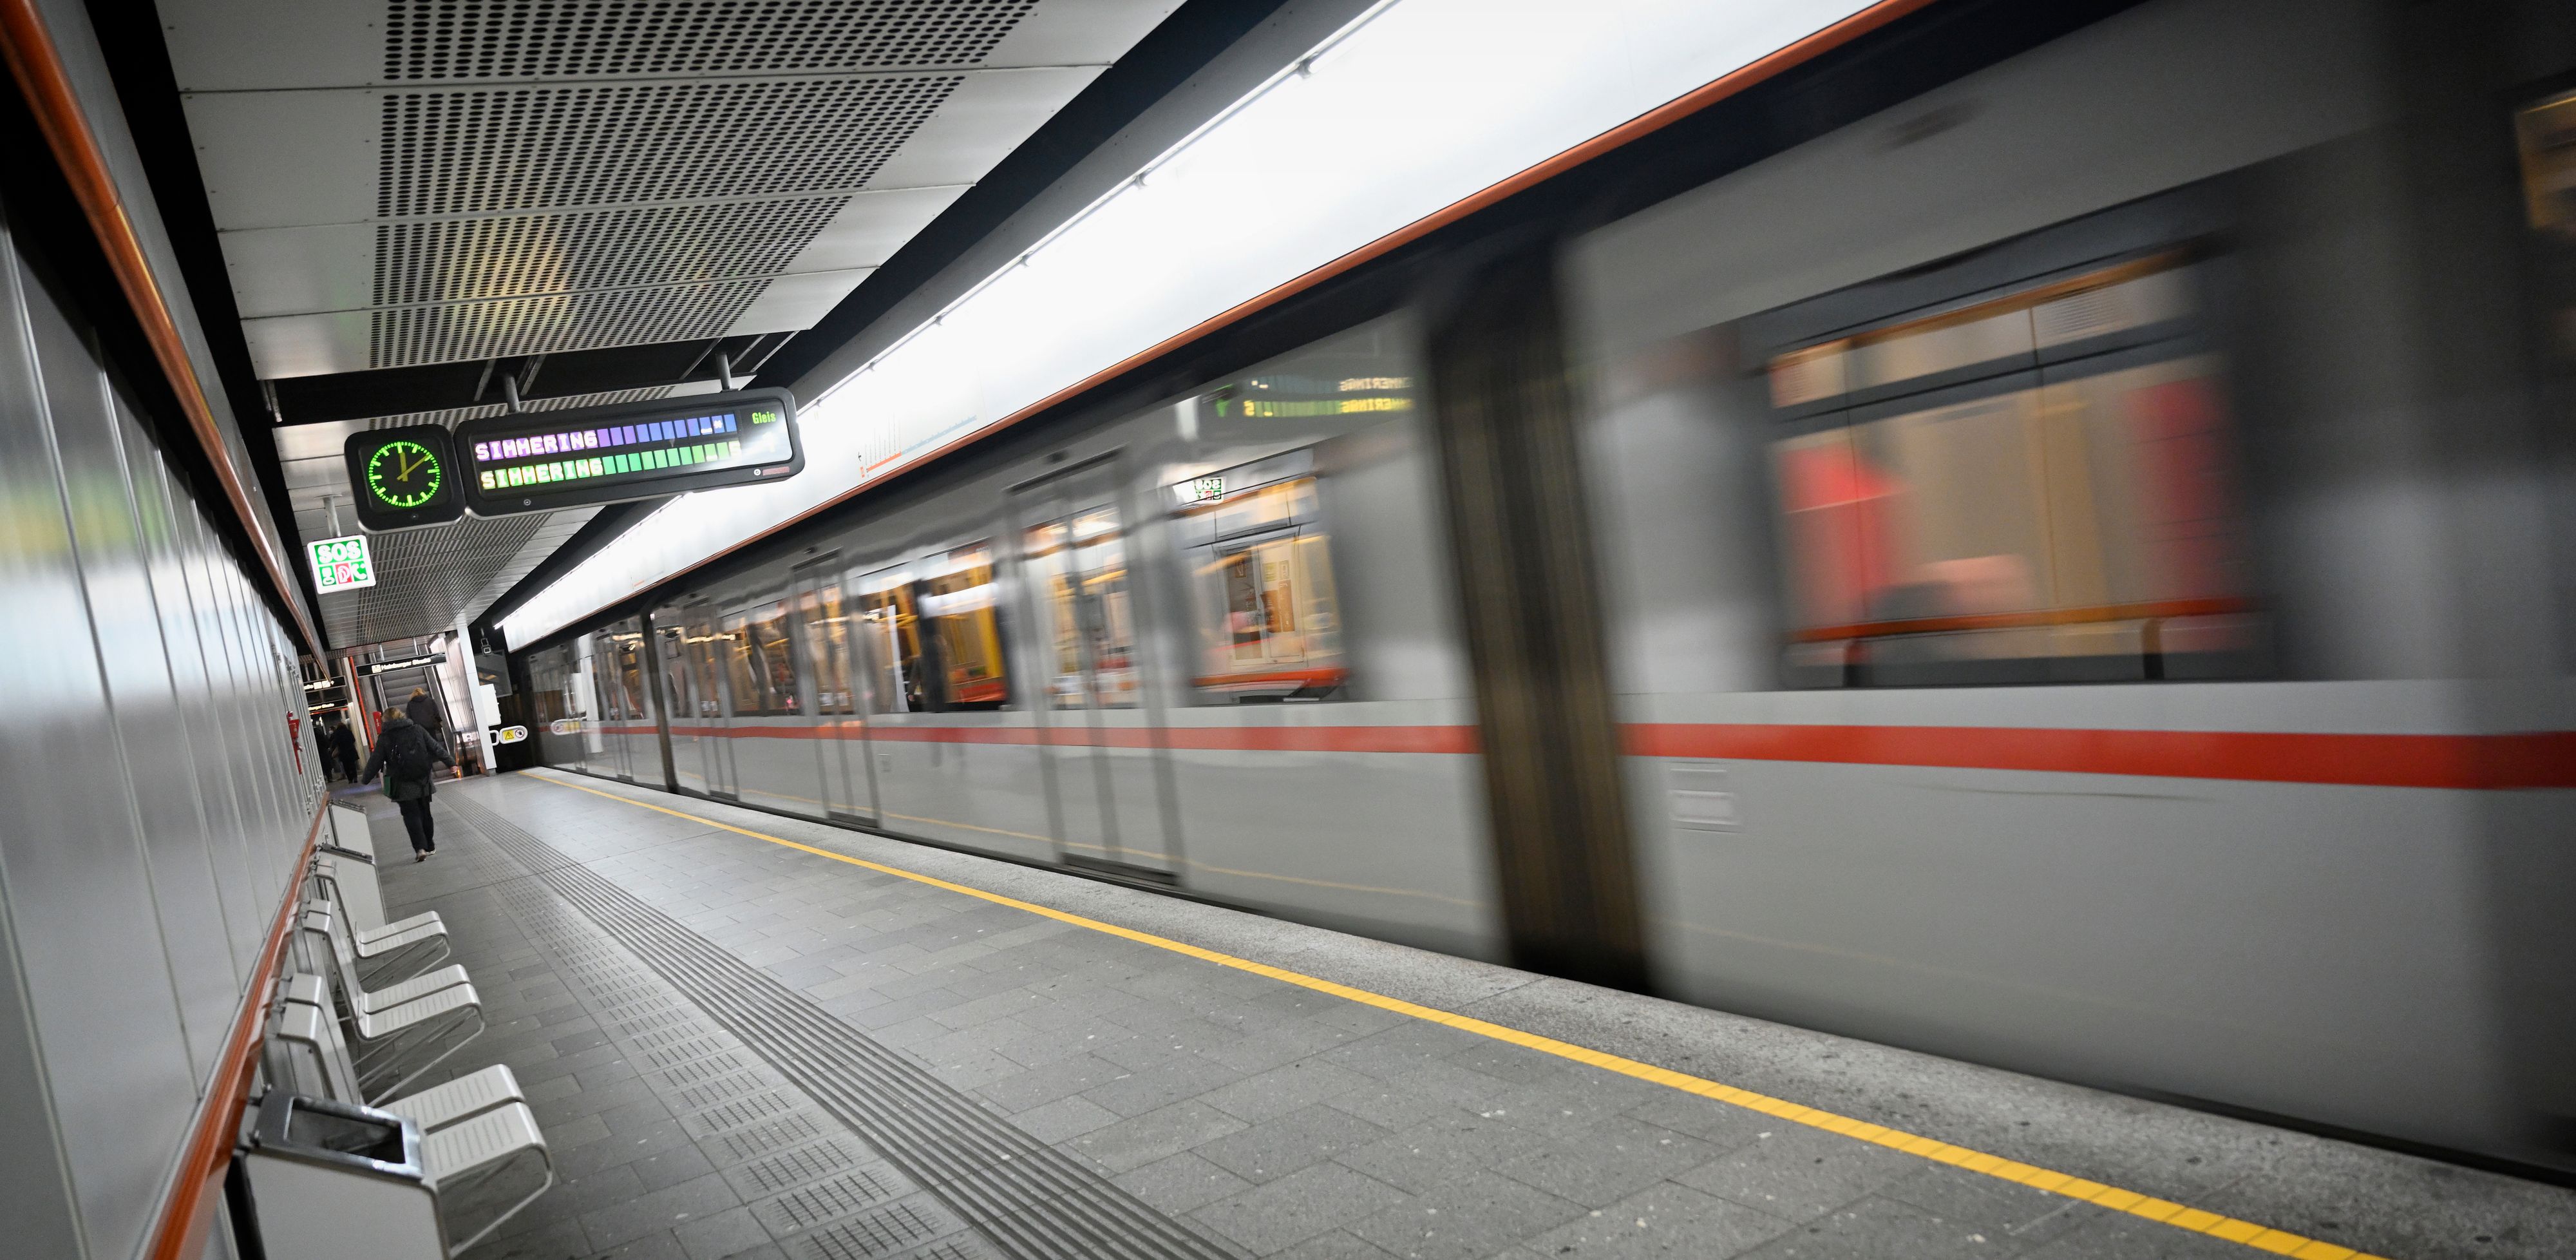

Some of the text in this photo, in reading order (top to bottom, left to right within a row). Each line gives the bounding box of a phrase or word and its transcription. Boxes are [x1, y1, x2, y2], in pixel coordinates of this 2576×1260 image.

[752, 411, 777, 425] Gleis
[475, 432, 598, 461] SIMMERING
[481, 459, 603, 490] SIMMERING
[317, 540, 361, 564] SOS
